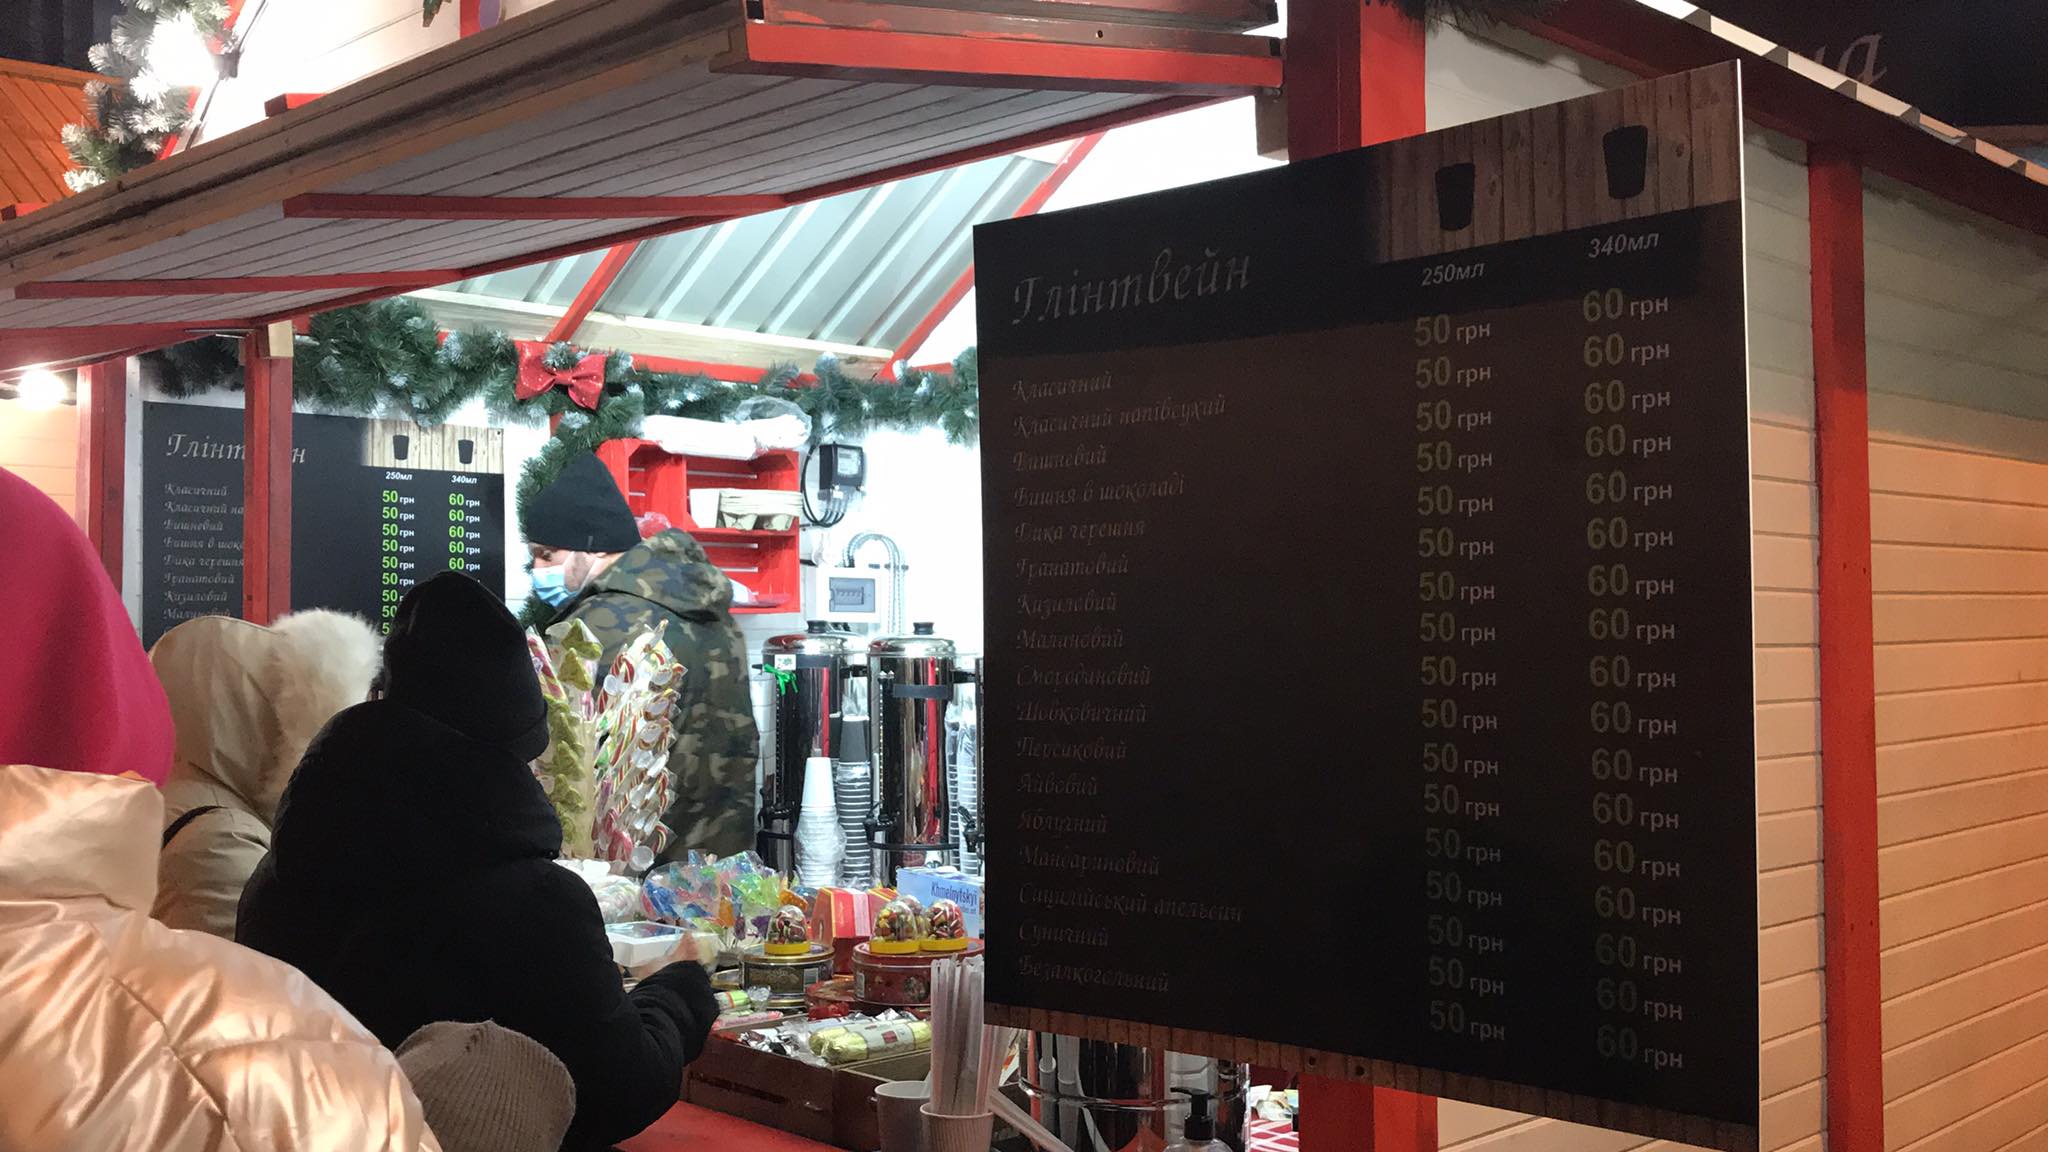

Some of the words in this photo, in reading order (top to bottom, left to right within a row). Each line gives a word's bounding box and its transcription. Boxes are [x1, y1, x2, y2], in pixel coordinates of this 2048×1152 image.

[1588, 231, 1660, 259] 340мл
[1011, 246, 1251, 325] Глінтвейн
[1421, 262, 1485, 287] 250мл
[1582, 288, 1624, 323] 60
[1630, 297, 1669, 321] грн
[1415, 314, 1451, 347] 50
[1456, 322, 1491, 345] грн
[1583, 332, 1625, 368] 60
[1631, 343, 1670, 367] грн
[1012, 371, 1114, 403] Класичний
[1415, 355, 1451, 389] 50
[1456, 366, 1491, 388] грн
[1584, 379, 1626, 415] 60
[1632, 391, 1671, 414] грн
[1013, 408, 1113, 440] Класичний
[1416, 399, 1452, 432] 50
[1457, 410, 1492, 432] грн
[166, 433, 305, 464] Глінтн
[1416, 440, 1453, 473] 50
[1457, 452, 1493, 474] грн
[1585, 423, 1626, 457] 60
[1632, 435, 1672, 459] грн
[385, 471, 413, 481] 250мл
[451, 475, 478, 484] 340мл
[1083, 479, 1095, 503] в
[1585, 470, 1627, 505] 60
[1633, 484, 1673, 507] грн
[382, 490, 398, 503] 50
[399, 496, 415, 505] грн
[382, 507, 398, 519] 50
[399, 512, 415, 522] грн
[449, 493, 464, 506] 60
[465, 499, 480, 509] грн
[1417, 484, 1453, 516] 50
[1458, 497, 1494, 518] грн
[382, 523, 398, 536] 50
[399, 529, 415, 538] грн
[449, 509, 464, 521] 60
[465, 515, 480, 524] грн
[449, 525, 464, 538] 60
[465, 531, 480, 540] грн
[382, 539, 398, 552] 50
[399, 545, 415, 554] грн
[449, 541, 464, 553] 60
[465, 547, 480, 556] грн
[1418, 527, 1454, 558] 50
[1459, 540, 1494, 561] грн
[1586, 516, 1628, 550] 60
[1634, 530, 1674, 553] грн
[382, 556, 398, 568] 50
[399, 561, 415, 571] грн
[382, 572, 398, 585] 50
[399, 578, 415, 587] грн
[449, 557, 464, 570] 60
[465, 563, 480, 572] грн
[382, 589, 398, 602] 50
[1419, 570, 1455, 602] 50
[1460, 585, 1495, 605] грн
[1587, 563, 1629, 597] 60
[1635, 579, 1674, 600] грн
[1419, 612, 1456, 642] 50
[1461, 627, 1496, 646] грн
[1588, 607, 1630, 640] 60
[1636, 623, 1675, 645] грн
[1421, 655, 1457, 686] 50
[1462, 671, 1497, 691] грн
[1589, 655, 1631, 688] 60
[1637, 671, 1676, 693] грн
[1421, 698, 1458, 729] 50
[1462, 715, 1498, 734] грн
[1590, 701, 1632, 734] 60
[1638, 718, 1677, 739] грн
[1422, 742, 1459, 773] 50
[1464, 759, 1499, 779] грн
[1591, 747, 1633, 781] 60
[1639, 766, 1678, 787] грн
[1423, 783, 1460, 814] 50
[1465, 801, 1500, 821] грн
[1592, 791, 1634, 826] 60
[1640, 811, 1679, 833] грн
[1425, 827, 1461, 859] 50
[1466, 845, 1502, 866] грн
[1593, 838, 1635, 874] 60
[1641, 860, 1681, 881] грн
[1426, 870, 1462, 903] 50
[1467, 889, 1503, 910] грн
[1594, 885, 1636, 920] 60
[1642, 906, 1682, 928] грн
[1427, 914, 1463, 947] 50
[1468, 934, 1504, 955] грн
[1595, 932, 1637, 968] 60
[1643, 955, 1682, 977] грн
[1428, 955, 1464, 989] 50
[1469, 977, 1504, 997] грн
[1595, 977, 1638, 1013] 60
[1643, 1000, 1683, 1022] грн
[1429, 999, 1465, 1033] 50
[1470, 1021, 1505, 1041] грн
[1596, 1023, 1638, 1060] 60
[1644, 1048, 1683, 1070] грн
